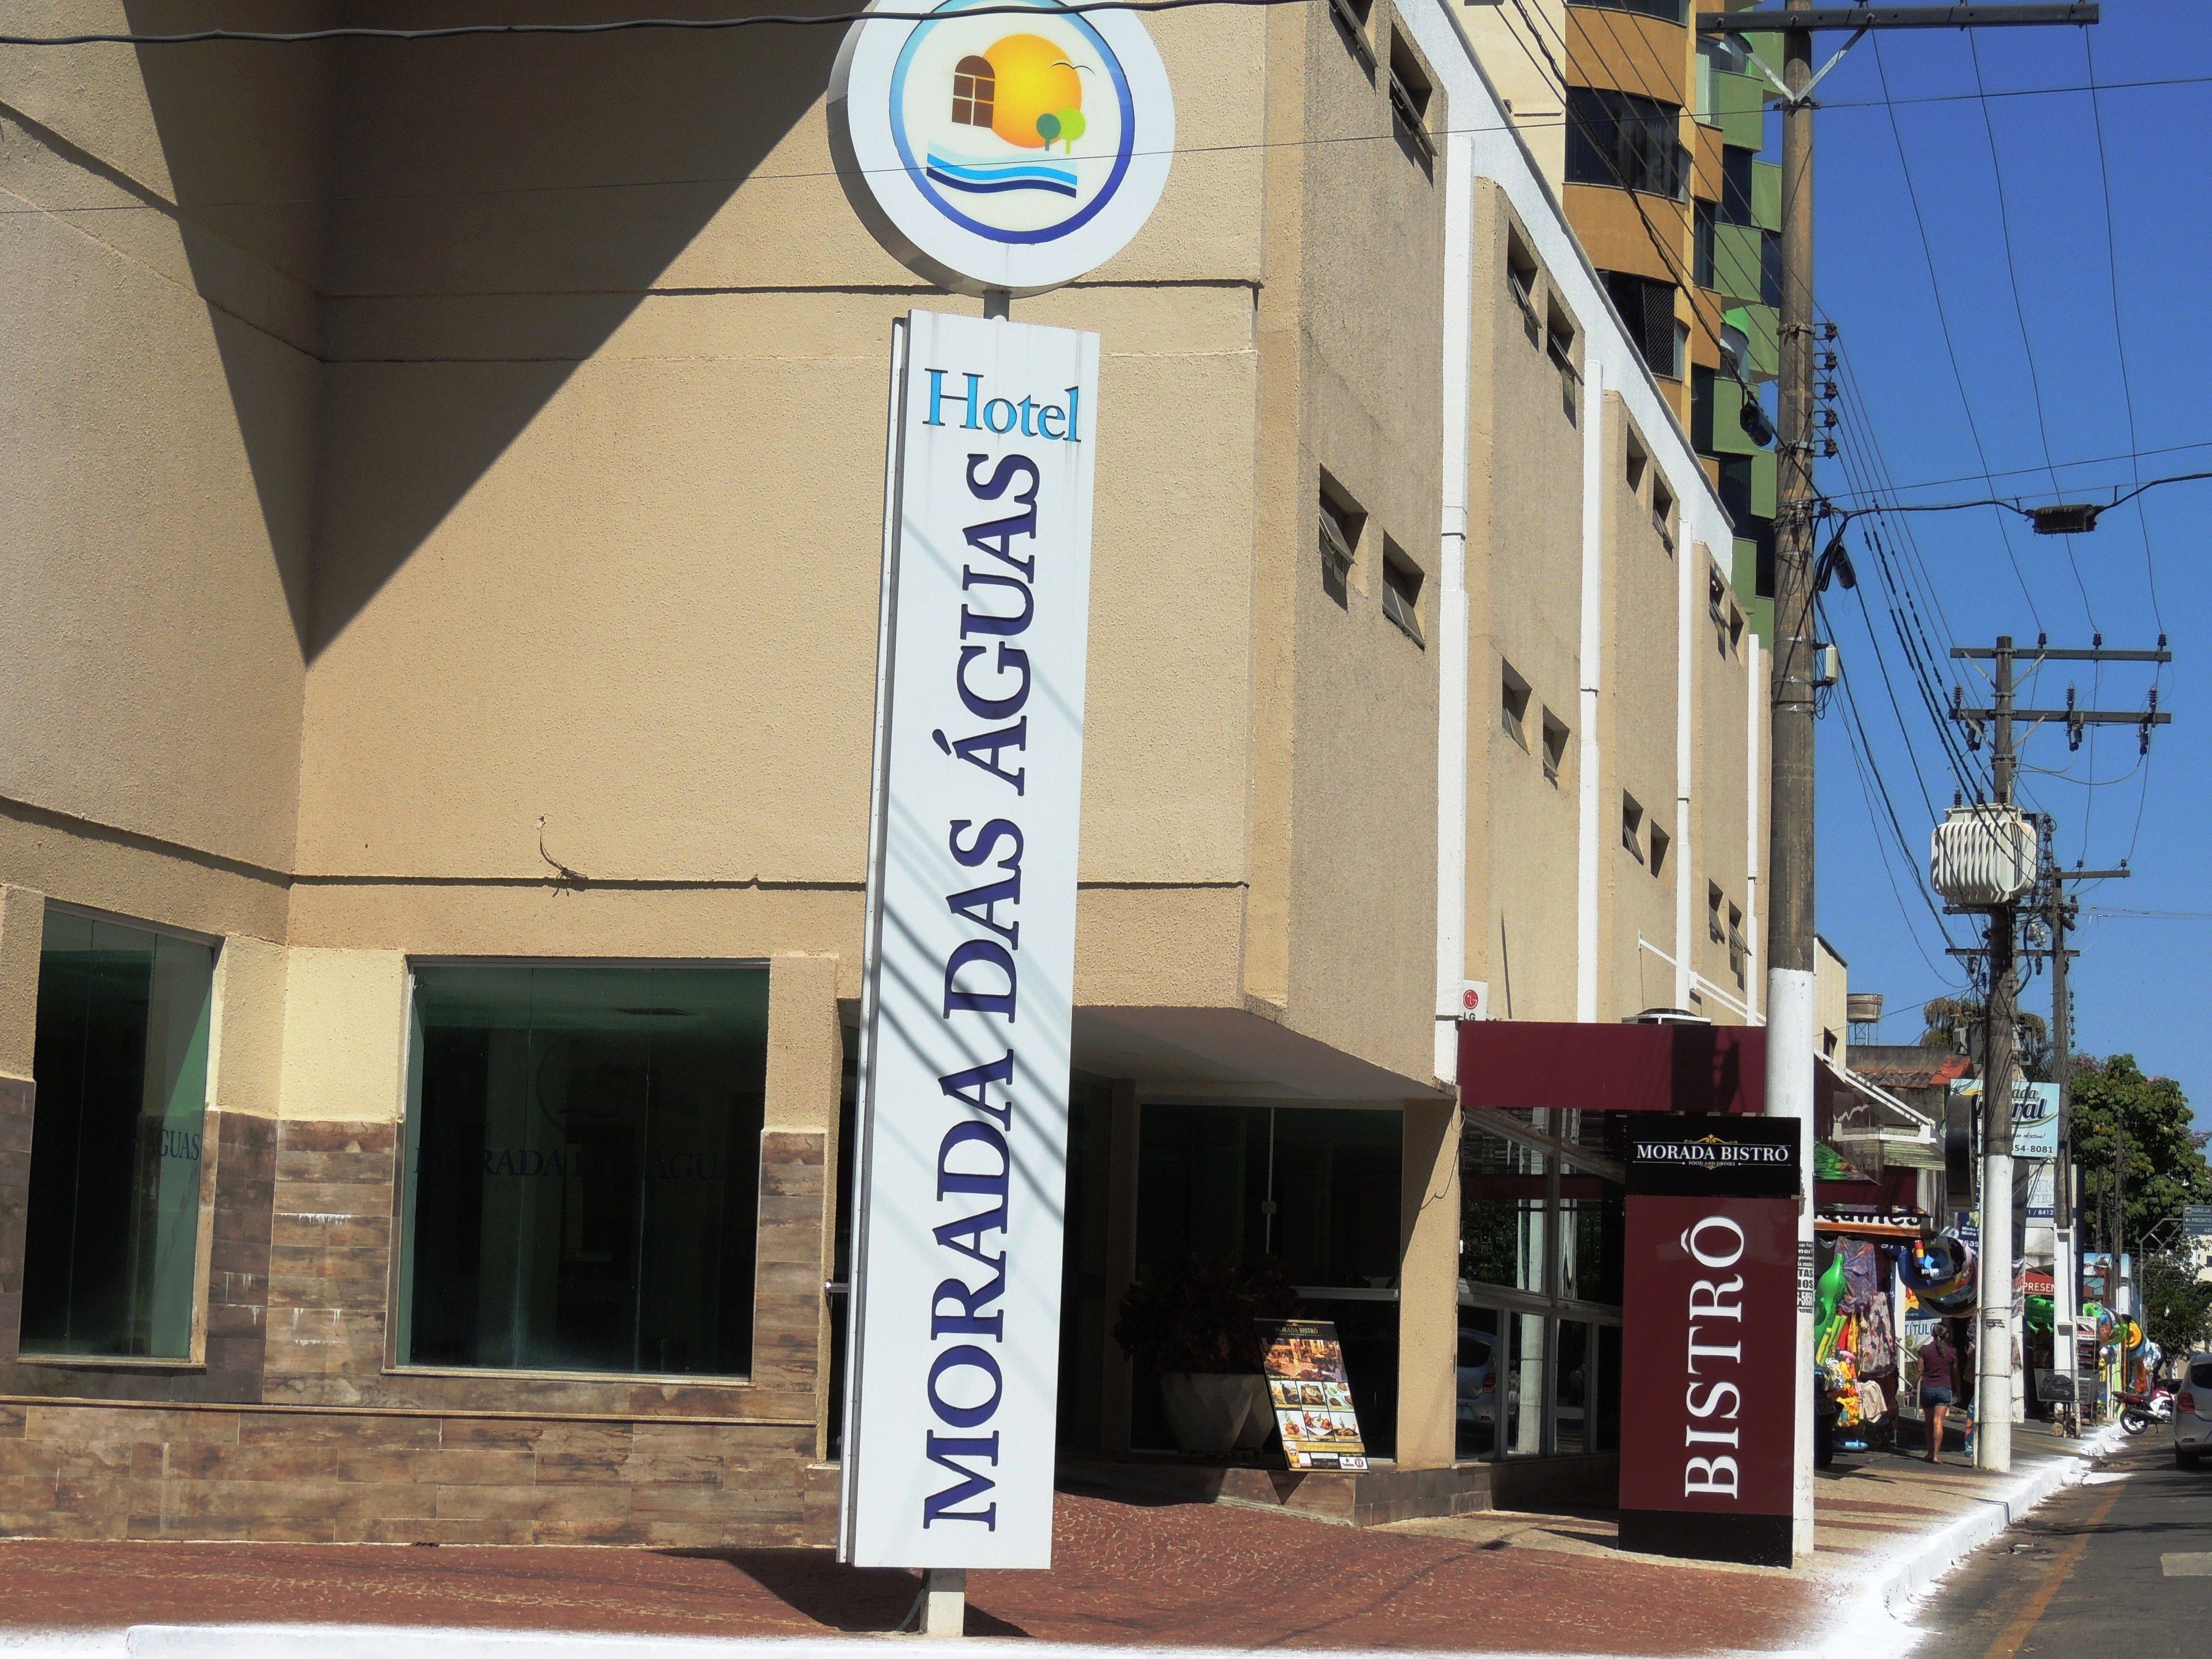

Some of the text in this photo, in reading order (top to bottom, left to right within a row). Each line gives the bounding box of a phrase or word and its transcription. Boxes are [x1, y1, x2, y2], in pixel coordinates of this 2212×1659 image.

[922, 368, 1081, 443] Hotel
[923, 453, 1040, 1532] MORADA DAS ÁGUAS
[1463, 1012, 1476, 1021] LG
[1636, 1145, 1789, 1161] MORADA BISTRÔ
[1681, 1215, 1745, 1500] BISTRÔ
